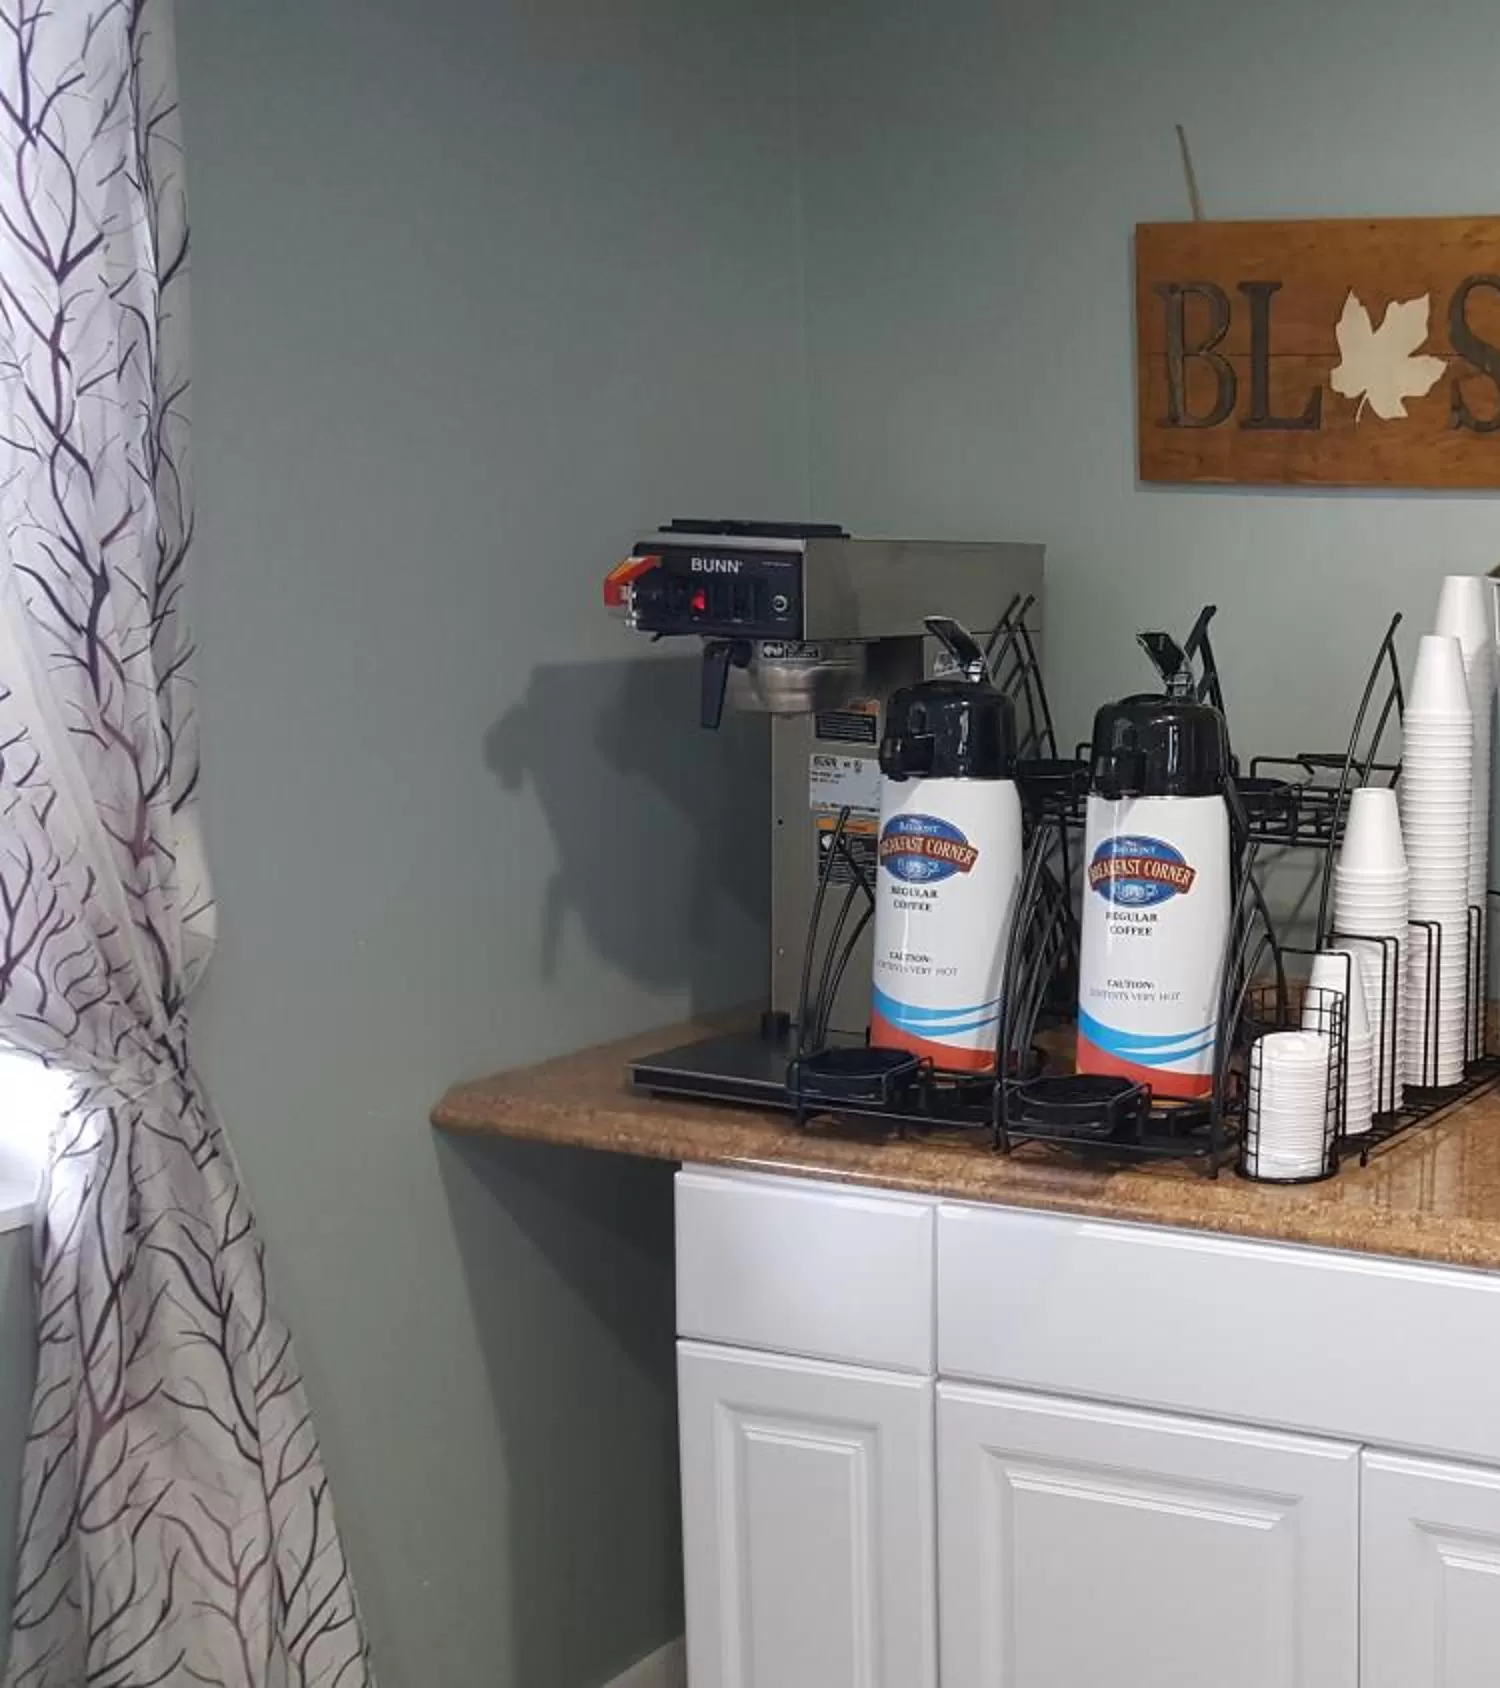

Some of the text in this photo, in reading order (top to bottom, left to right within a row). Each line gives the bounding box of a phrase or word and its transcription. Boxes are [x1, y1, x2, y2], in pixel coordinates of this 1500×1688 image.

[691, 557, 740, 574] BUNN
[926, 838, 974, 866] CORNER
[1142, 860, 1193, 888] CORNER
[1105, 910, 1158, 923] REGULAR
[1109, 925, 1153, 937] COFFEE
